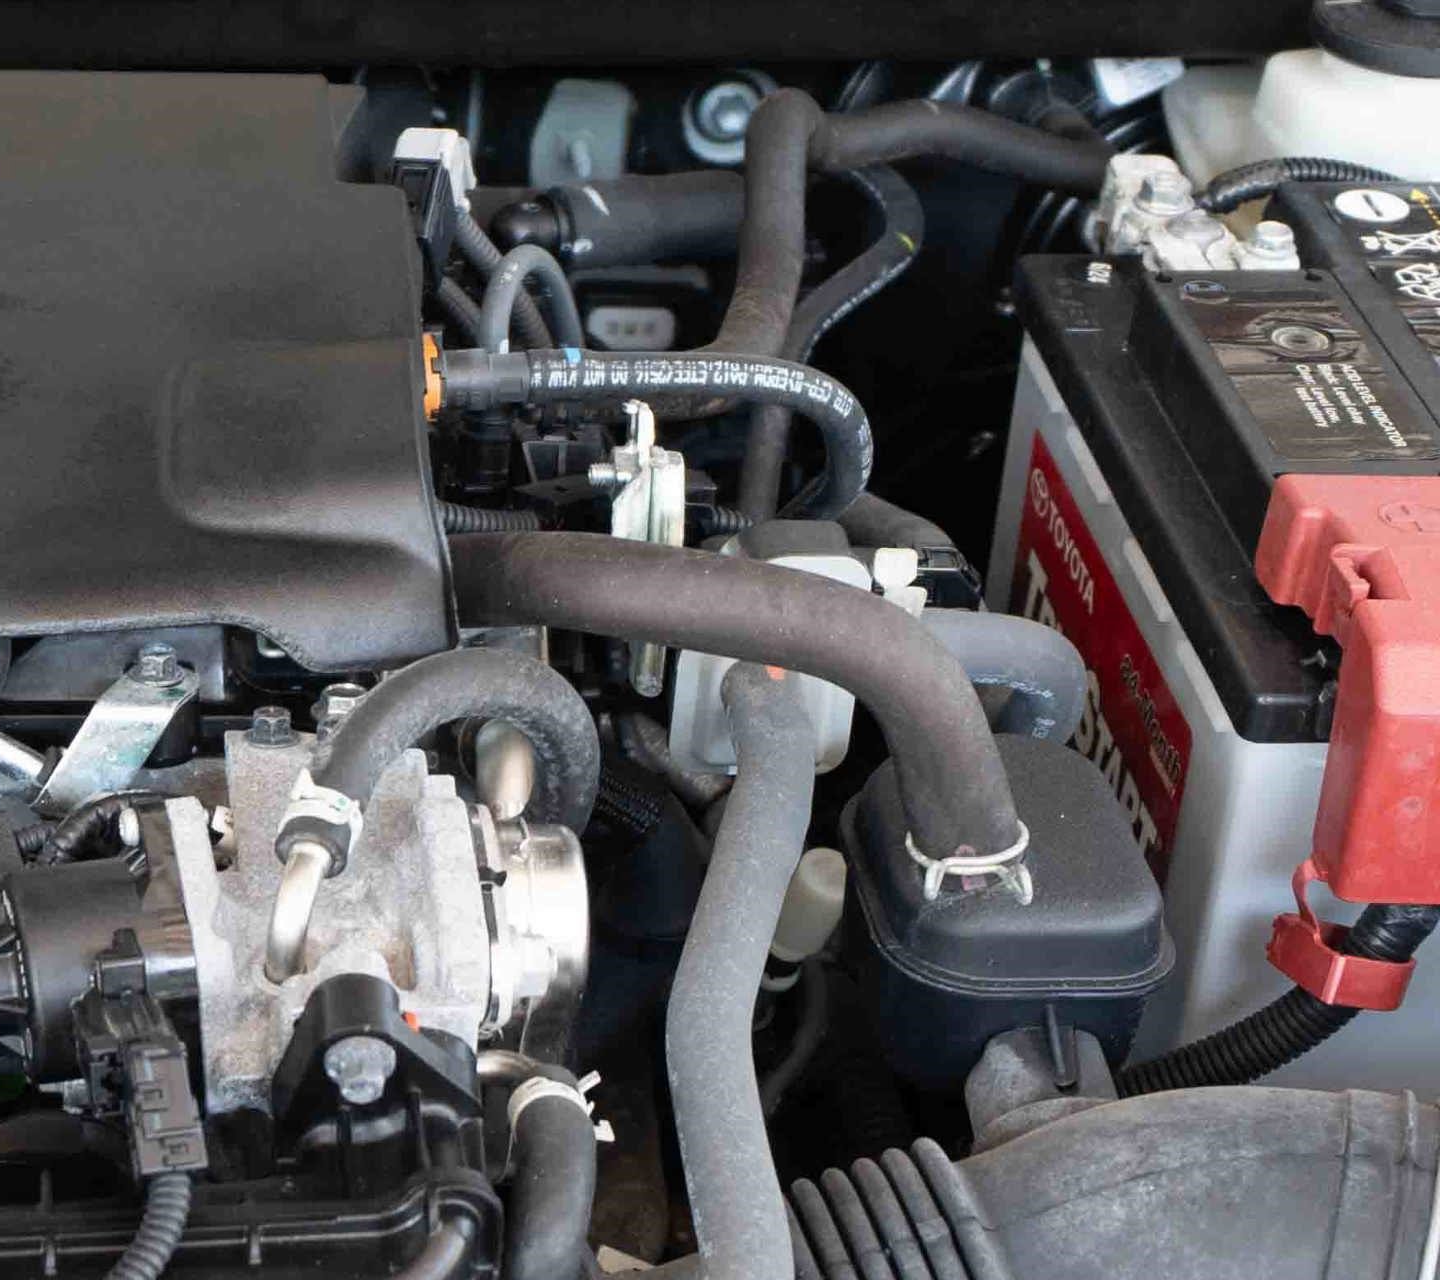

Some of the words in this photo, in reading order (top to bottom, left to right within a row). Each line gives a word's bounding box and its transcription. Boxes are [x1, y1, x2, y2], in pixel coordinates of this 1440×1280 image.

[1340, 365, 1362, 382] ACID
[1355, 382, 1377, 404] LEVEL
[1369, 406, 1409, 447] INDICATOR
[1047, 504, 1094, 614] TOYOTA
